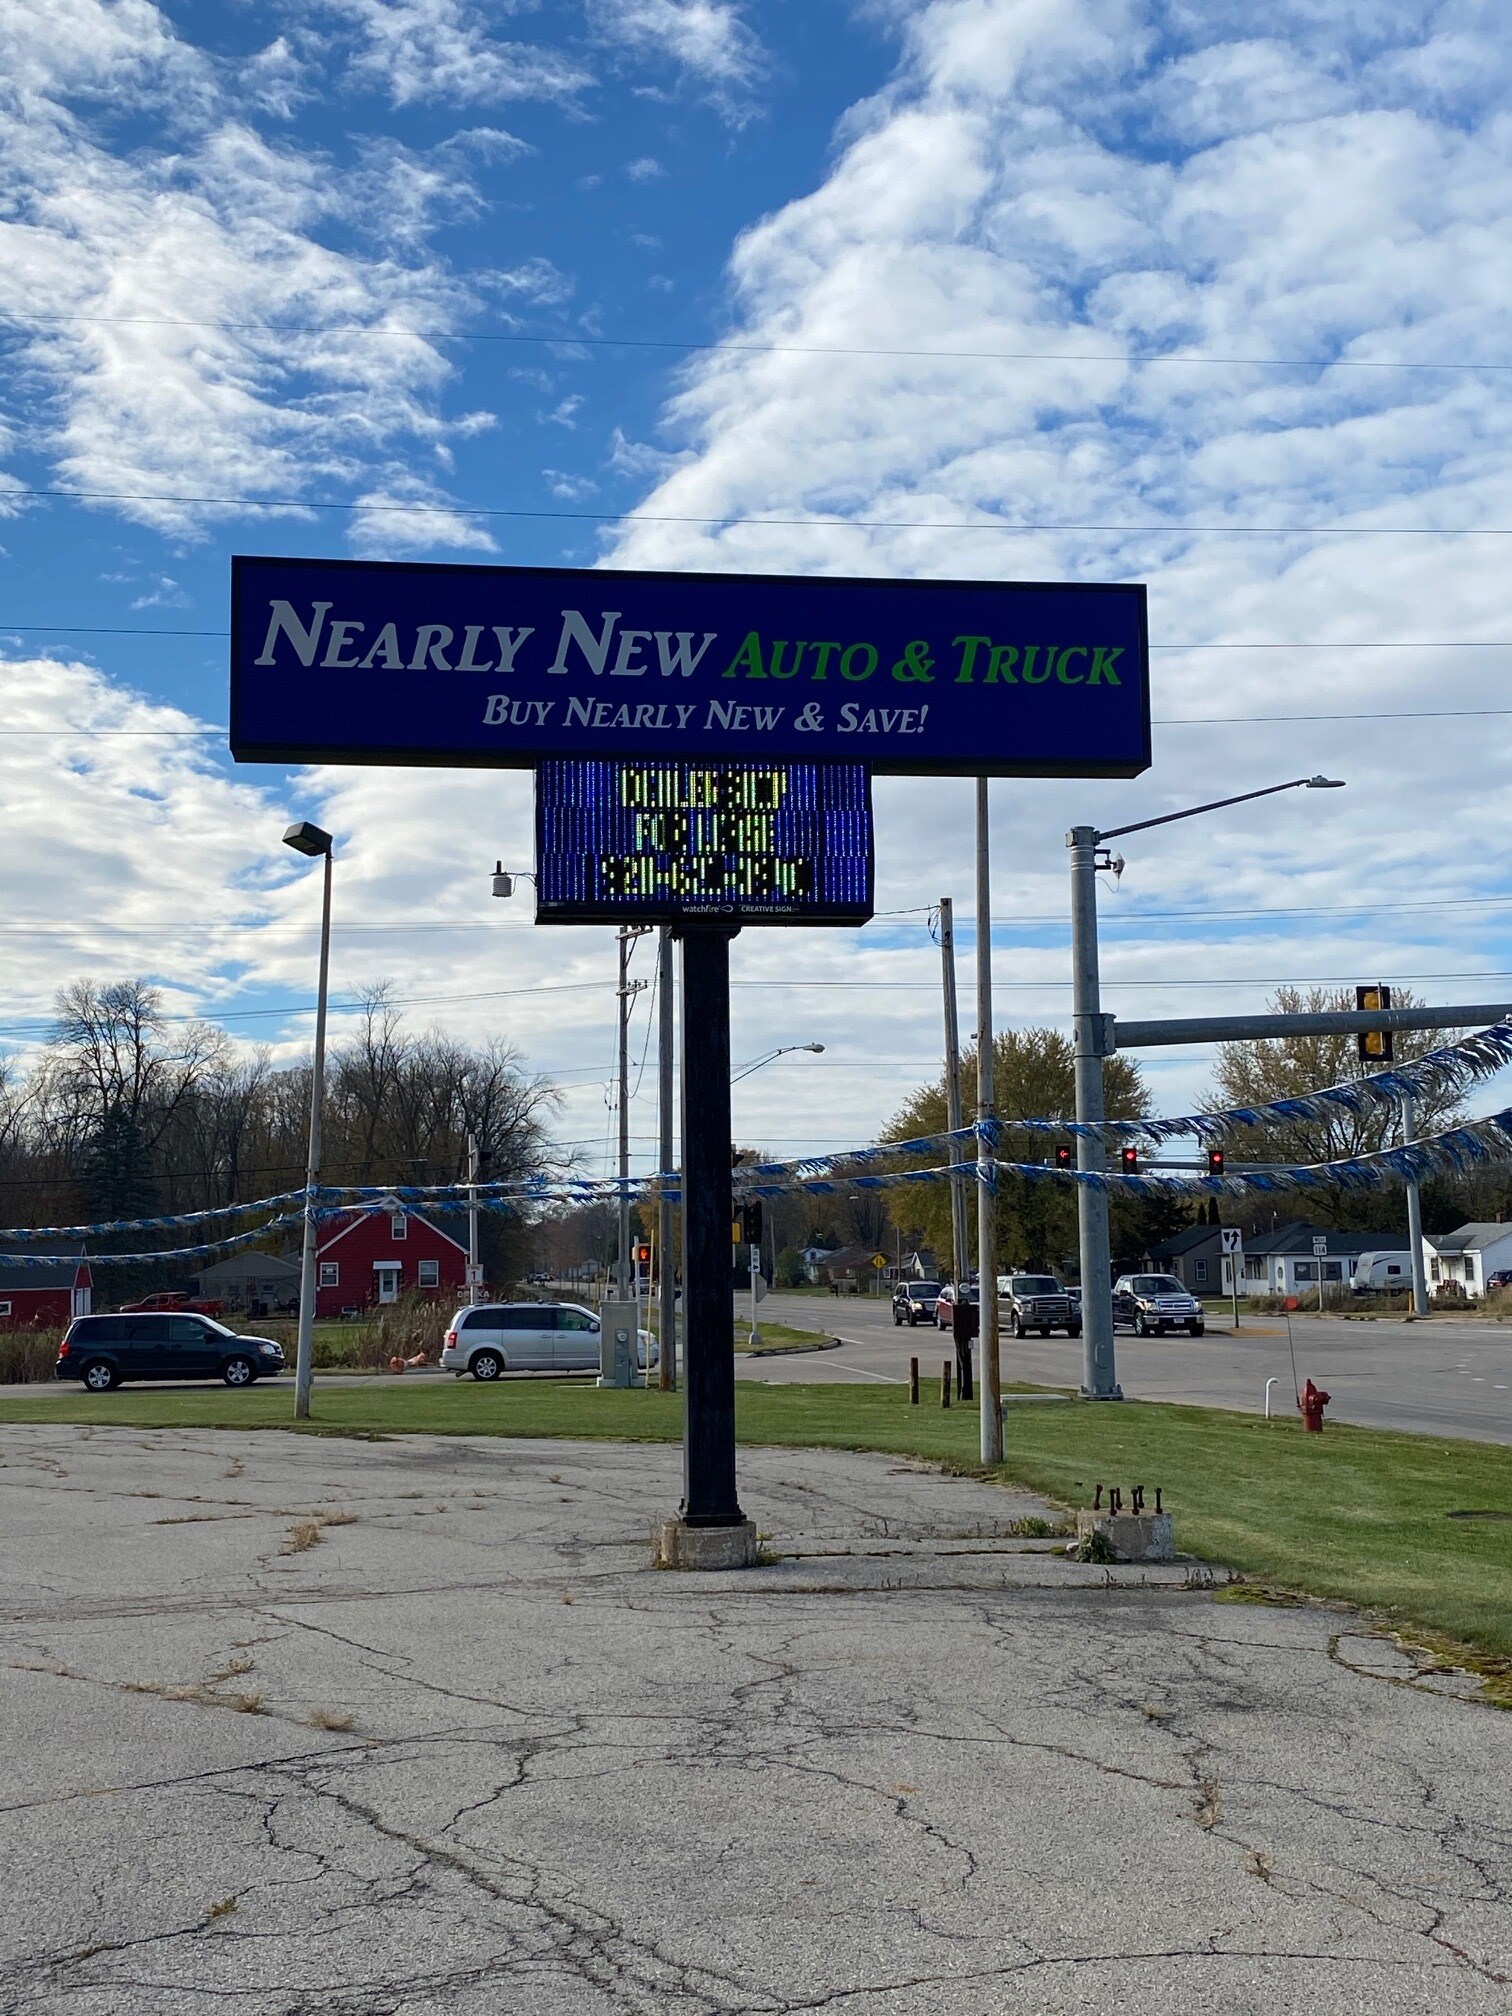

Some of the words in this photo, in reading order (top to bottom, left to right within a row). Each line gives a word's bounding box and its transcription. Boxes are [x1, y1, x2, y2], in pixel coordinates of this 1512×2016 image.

[254, 600, 535, 672] NEARLY
[547, 610, 717, 676] NEW
[722, 632, 878, 680] AUTO
[892, 641, 935, 682] &
[952, 636, 1125, 685] TRUCK
[482, 695, 555, 725] BUY
[562, 697, 697, 728] NEARLY
[703, 700, 785, 730] NEW
[794, 702, 824, 731] &
[837, 703, 928, 733] SAVE!
[682, 904, 720, 913] watchfire
[741, 905, 774, 913] CREATIVE
[775, 905, 792, 913] SIGN
